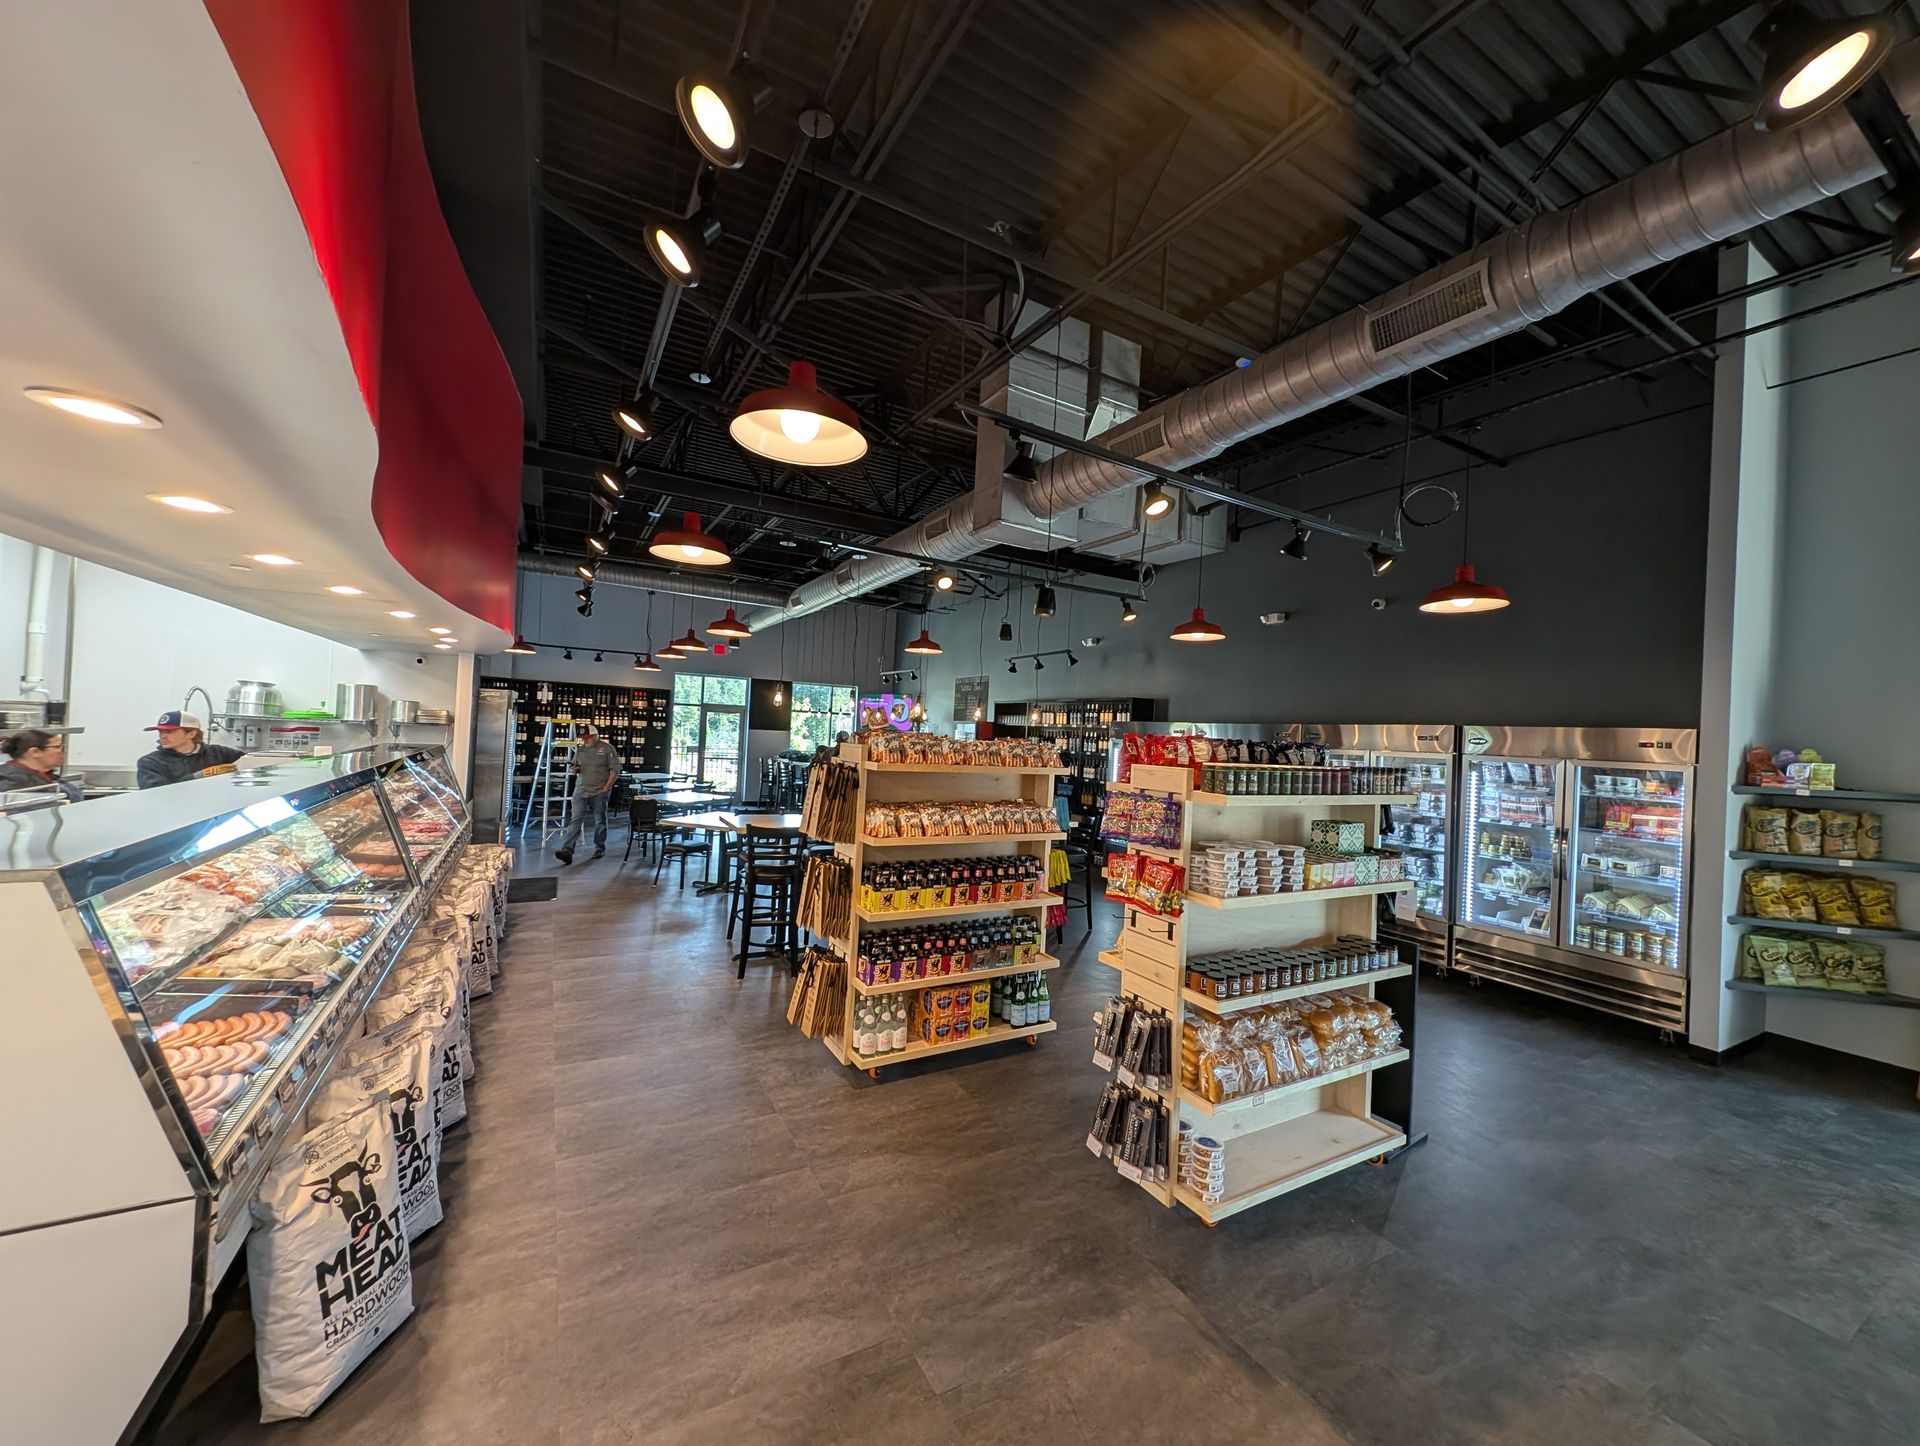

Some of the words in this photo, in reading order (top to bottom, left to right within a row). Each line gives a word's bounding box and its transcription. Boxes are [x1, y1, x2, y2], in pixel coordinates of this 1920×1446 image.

[398, 1131, 431, 1173] EAT
[398, 1154, 432, 1197] EAD
[402, 1179, 435, 1211] WOOD
[315, 1205, 401, 1292] MEAT
[319, 1232, 405, 1321] HEAD
[323, 1315, 341, 1330] ALL
[342, 1287, 378, 1317] NATURAL
[324, 1261, 409, 1342] HARDWOOD
[326, 1325, 357, 1350] CRAFT
[358, 1303, 384, 1327] CHUNK
